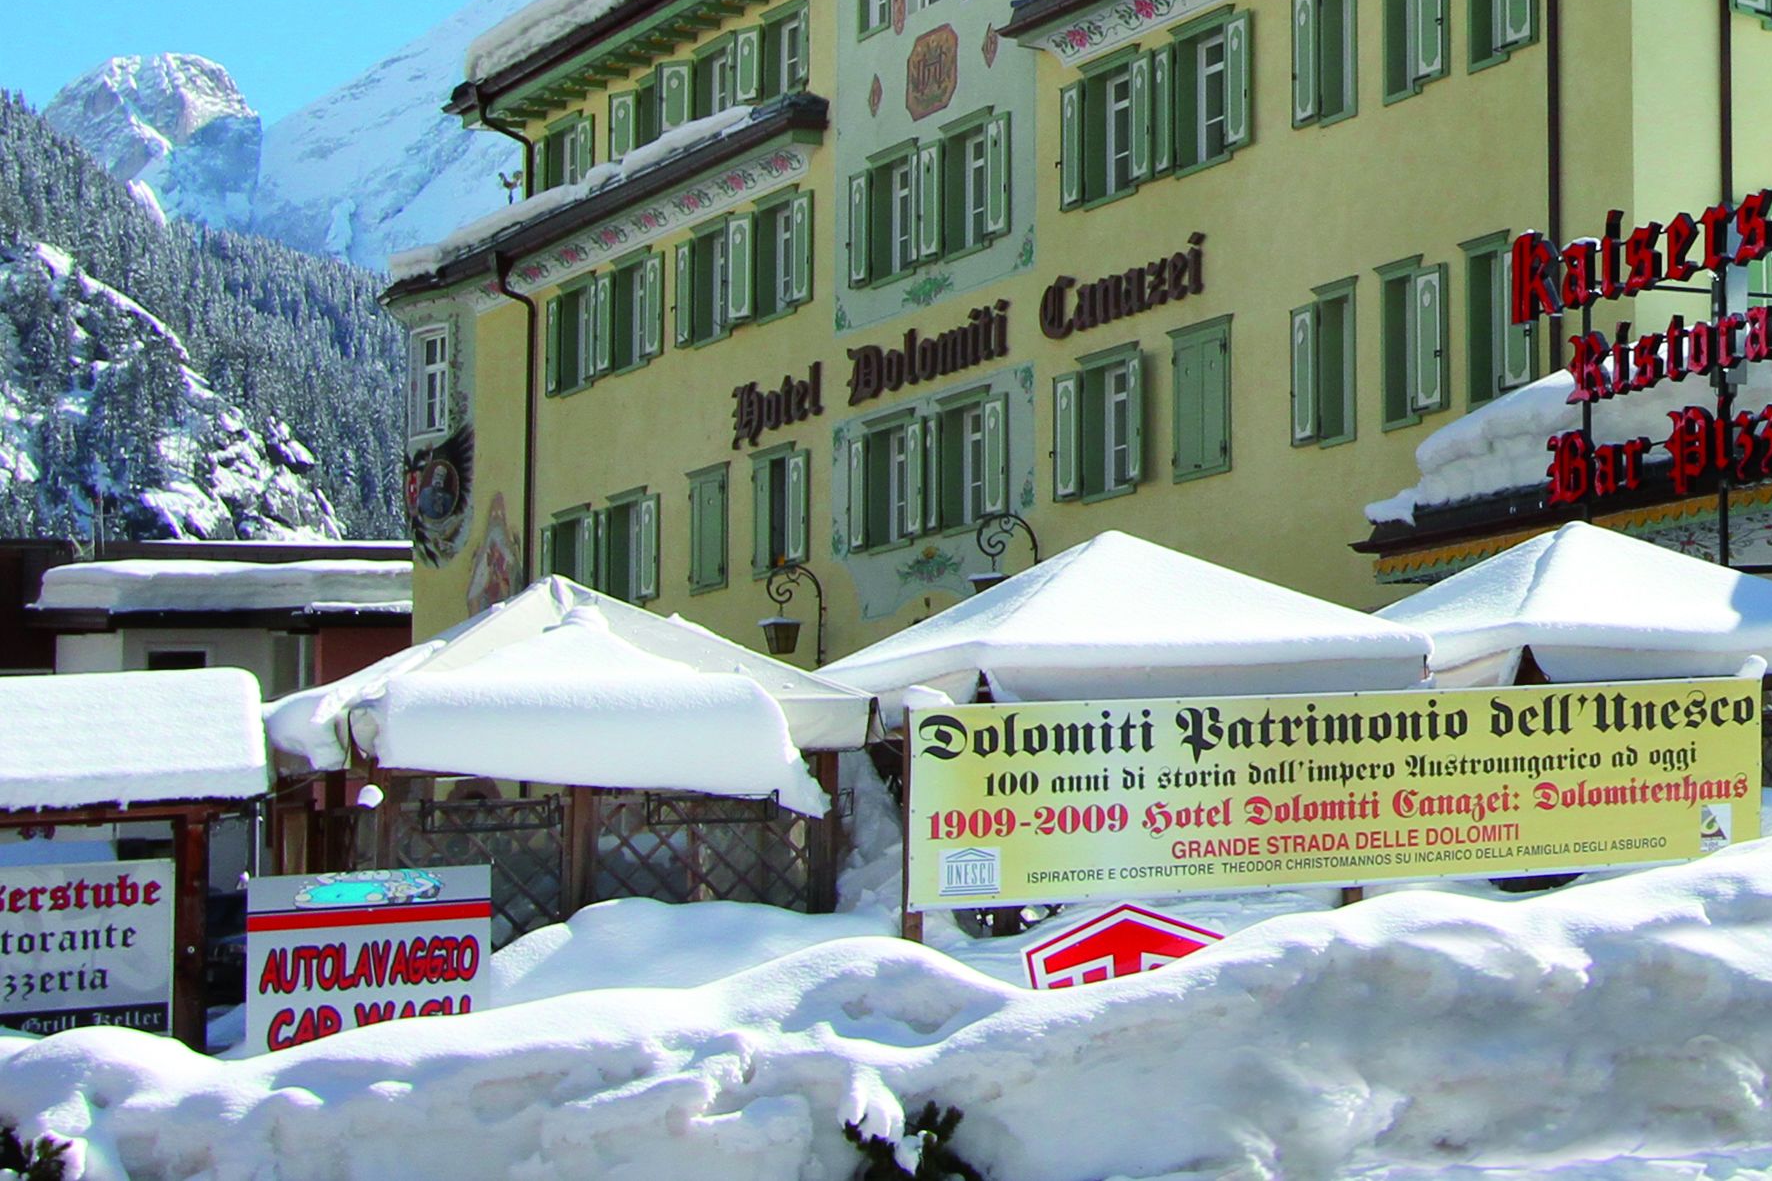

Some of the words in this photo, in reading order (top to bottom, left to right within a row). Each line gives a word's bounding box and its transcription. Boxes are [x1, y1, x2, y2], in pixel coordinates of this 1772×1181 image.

[732, 361, 824, 450] Hotel
[847, 298, 1010, 406] Dolomiti
[1039, 231, 1206, 339] Canazei
[1546, 429, 1650, 506] Bar
[918, 708, 1155, 761] Dolomiti
[1175, 698, 1469, 764] Patrimonio
[1489, 689, 1756, 737] dell'Unesco
[983, 771, 1039, 797] 100
[1050, 768, 1110, 794] anni
[1121, 765, 1146, 790] di
[1157, 761, 1237, 789] storia
[1248, 758, 1396, 787] dall'impero
[1404, 747, 1601, 780] Austroungarico
[1611, 746, 1640, 768] ad
[1648, 741, 1698, 772] oggi
[926, 803, 1129, 840] 1909-2009
[1142, 798, 1232, 839] Hotel
[1244, 790, 1380, 825] Dolomiti
[1392, 784, 1522, 822] Canazei:
[1532, 772, 1750, 811] Dolomitenhaus
[1026, 870, 1105, 884] ISPIRATORE
[1107, 869, 1117, 881] E
[1119, 863, 1215, 880] COSTRUTTORE
[1221, 860, 1283, 873] THEODOR
[1285, 853, 1392, 871] CHRISTOMANNOS
[1395, 851, 1412, 865] SU
[1414, 848, 1473, 864] INCARICO
[1476, 845, 1514, 859] DELLA
[1516, 841, 1571, 857] FAMIGLIA
[1573, 838, 1608, 853] DEGLI
[1610, 836, 1668, 851] ASBURGO
[1171, 837, 1261, 860] GRANDE
[1266, 832, 1351, 855] STRADA
[1355, 828, 1419, 850] DELLE
[1425, 823, 1521, 846] DOLOMITI
[946, 862, 996, 886] UNESCO
[259, 934, 479, 994] AUTOLAVAGGIO
